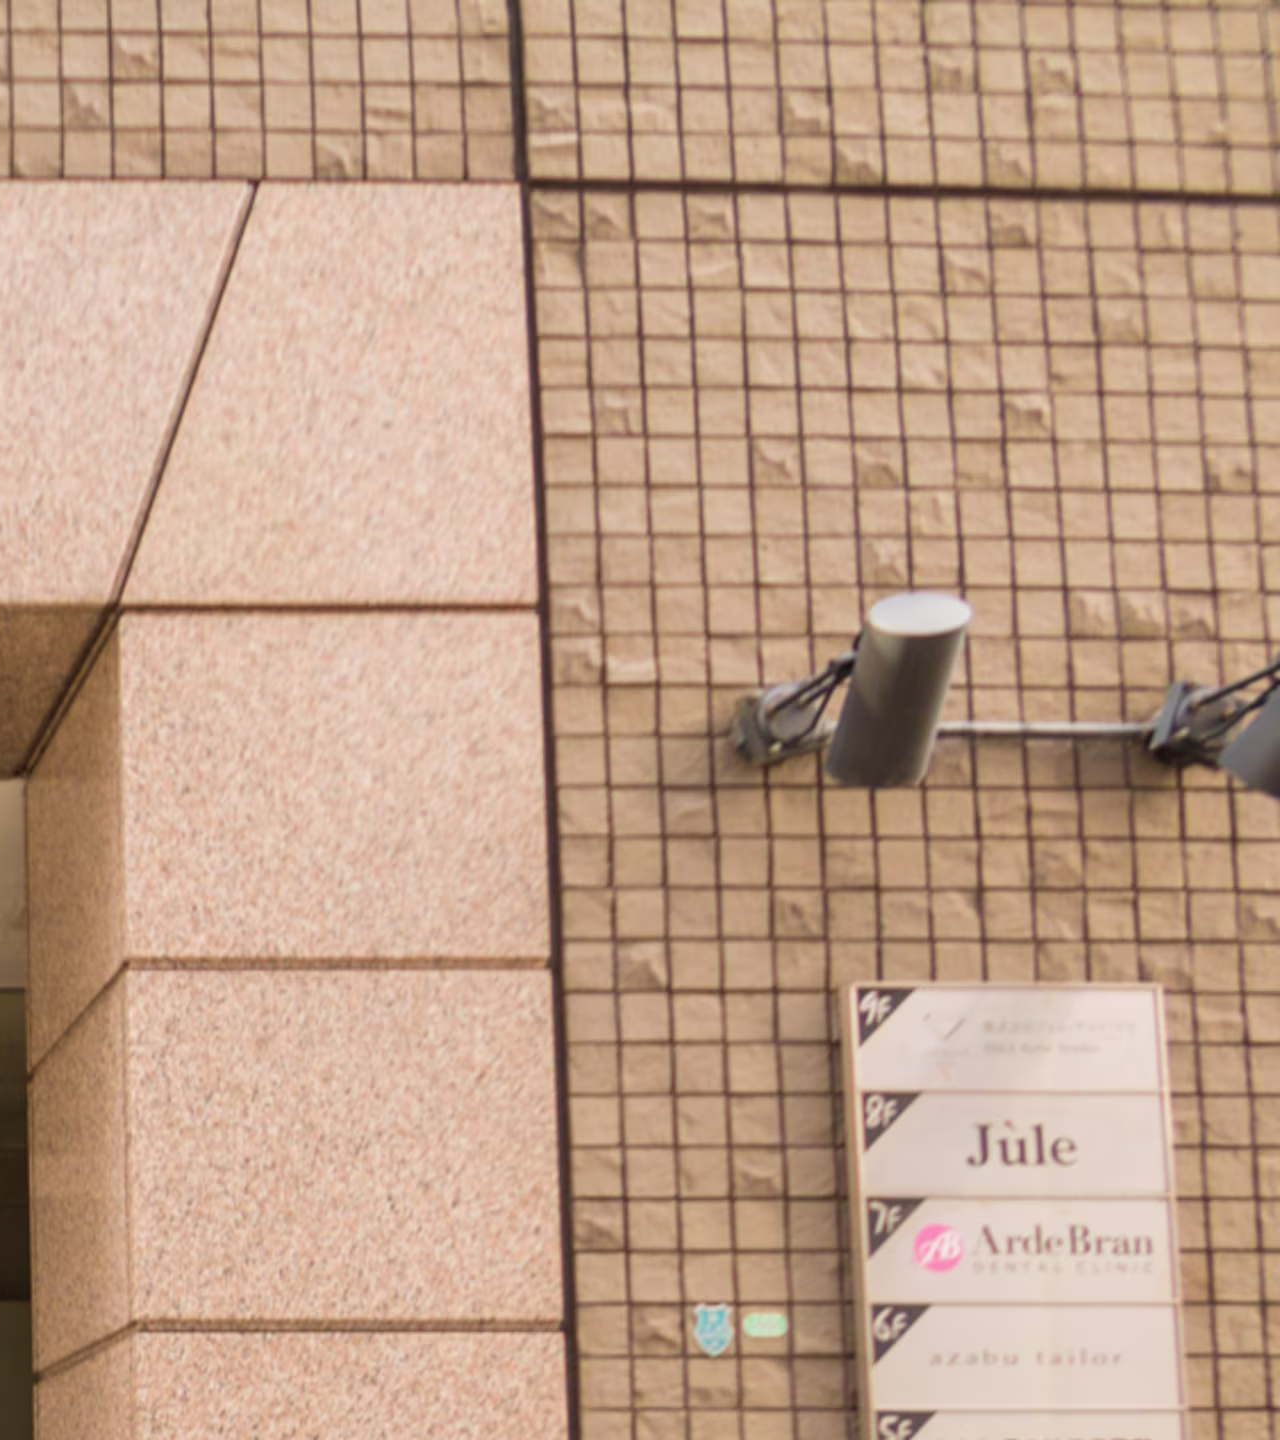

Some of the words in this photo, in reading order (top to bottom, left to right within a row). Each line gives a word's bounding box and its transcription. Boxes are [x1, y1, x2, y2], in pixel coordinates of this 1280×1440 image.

[860, 991, 890, 1025] 9F
[865, 1095, 898, 1129] 8F
[967, 1120, 1078, 1167] Jùle
[870, 1203, 902, 1235] 7F
[873, 1308, 907, 1342] 6F
[930, 1348, 1019, 1367] azabu
[1036, 1348, 1122, 1367] tailor
